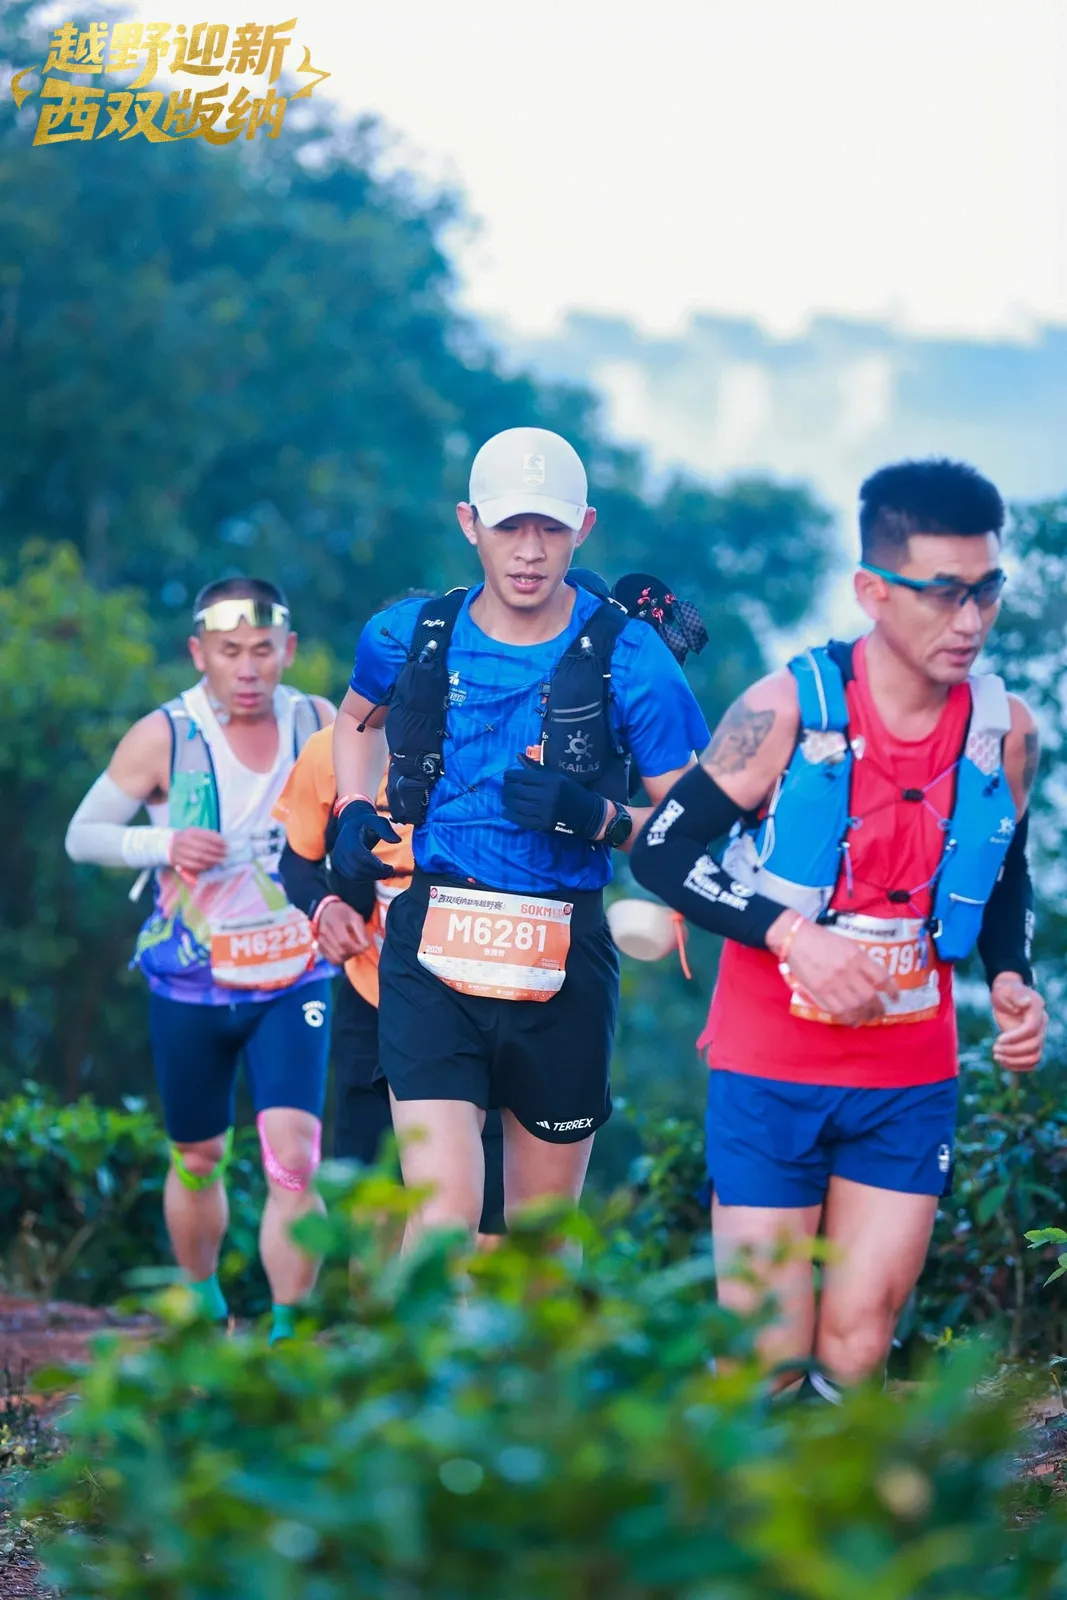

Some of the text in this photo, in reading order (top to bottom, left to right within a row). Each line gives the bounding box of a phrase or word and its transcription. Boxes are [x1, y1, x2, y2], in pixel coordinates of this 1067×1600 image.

[559, 760, 600, 772] KAILAS
[521, 904, 552, 917] 60KM
[447, 913, 547, 953] M6281
[553, 1118, 594, 1132] TERREX
